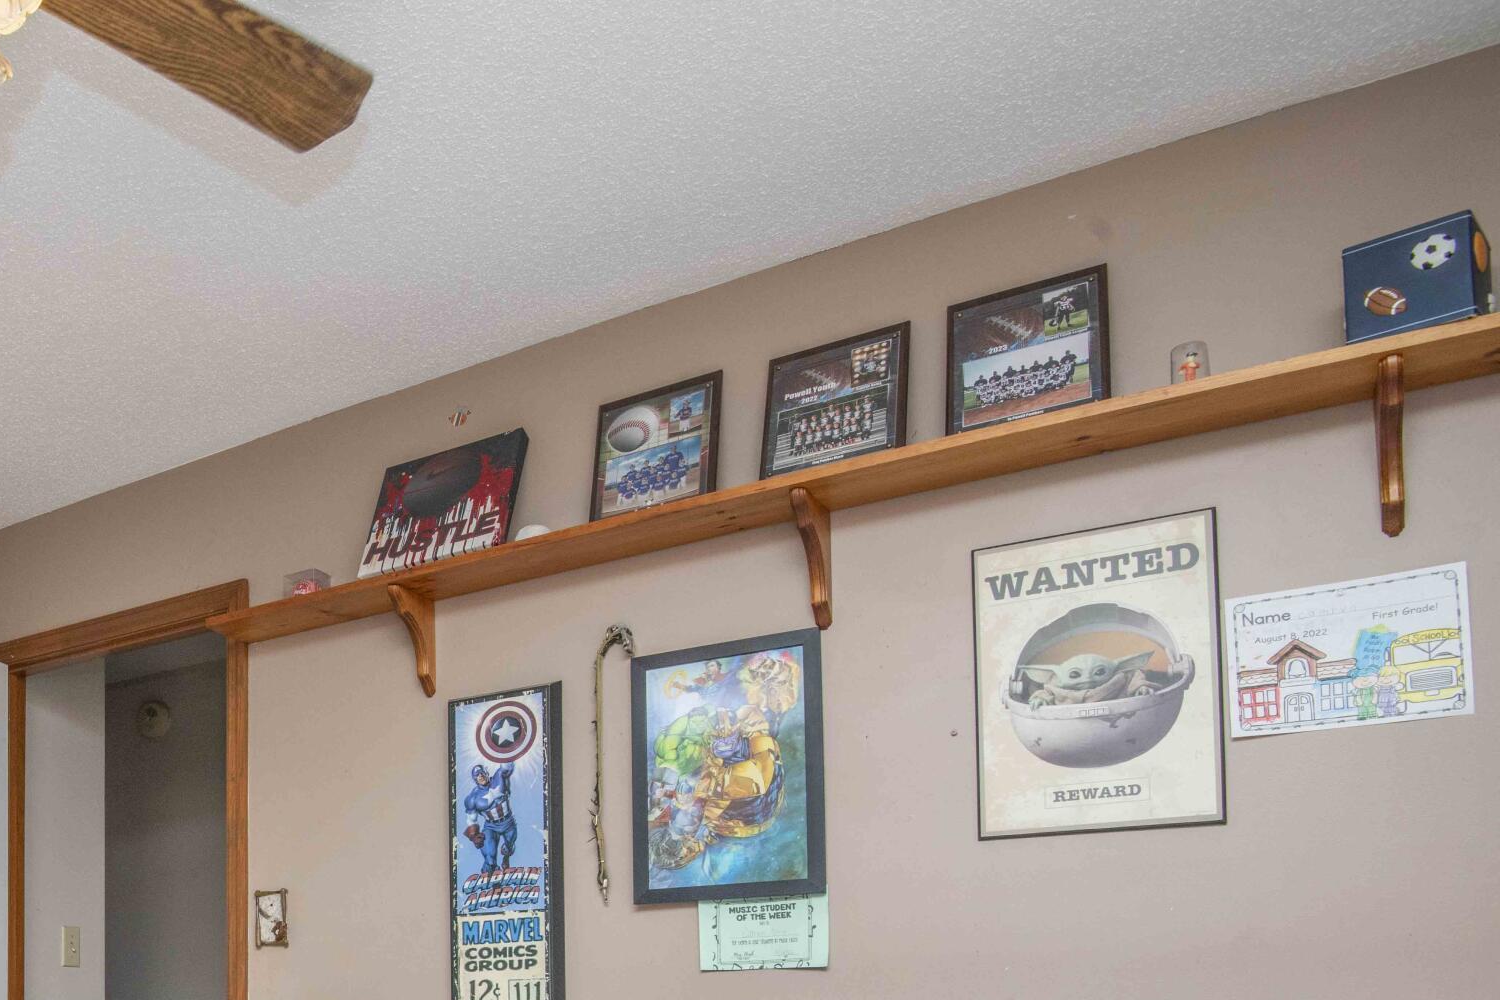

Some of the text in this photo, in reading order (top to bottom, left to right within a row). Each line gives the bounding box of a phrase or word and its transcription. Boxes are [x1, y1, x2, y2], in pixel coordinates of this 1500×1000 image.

[784, 387, 811, 401] Powell
[363, 509, 500, 566] HUSTLE
[984, 542, 1200, 600] WANTED
[1242, 611, 1292, 628] Name
[1372, 602, 1439, 621] First Grade!
[1254, 632, 1288, 645] August
[1302, 627, 1329, 639] 2022
[1052, 783, 1142, 803] REWARD
[462, 867, 542, 895] CAPTAIN
[462, 885, 541, 912] AMERICA
[728, 903, 797, 914] MUSIC STUDENT
[462, 916, 543, 946] MARVEL
[464, 945, 538, 960] COMICS
[464, 958, 538, 972] GROUP
